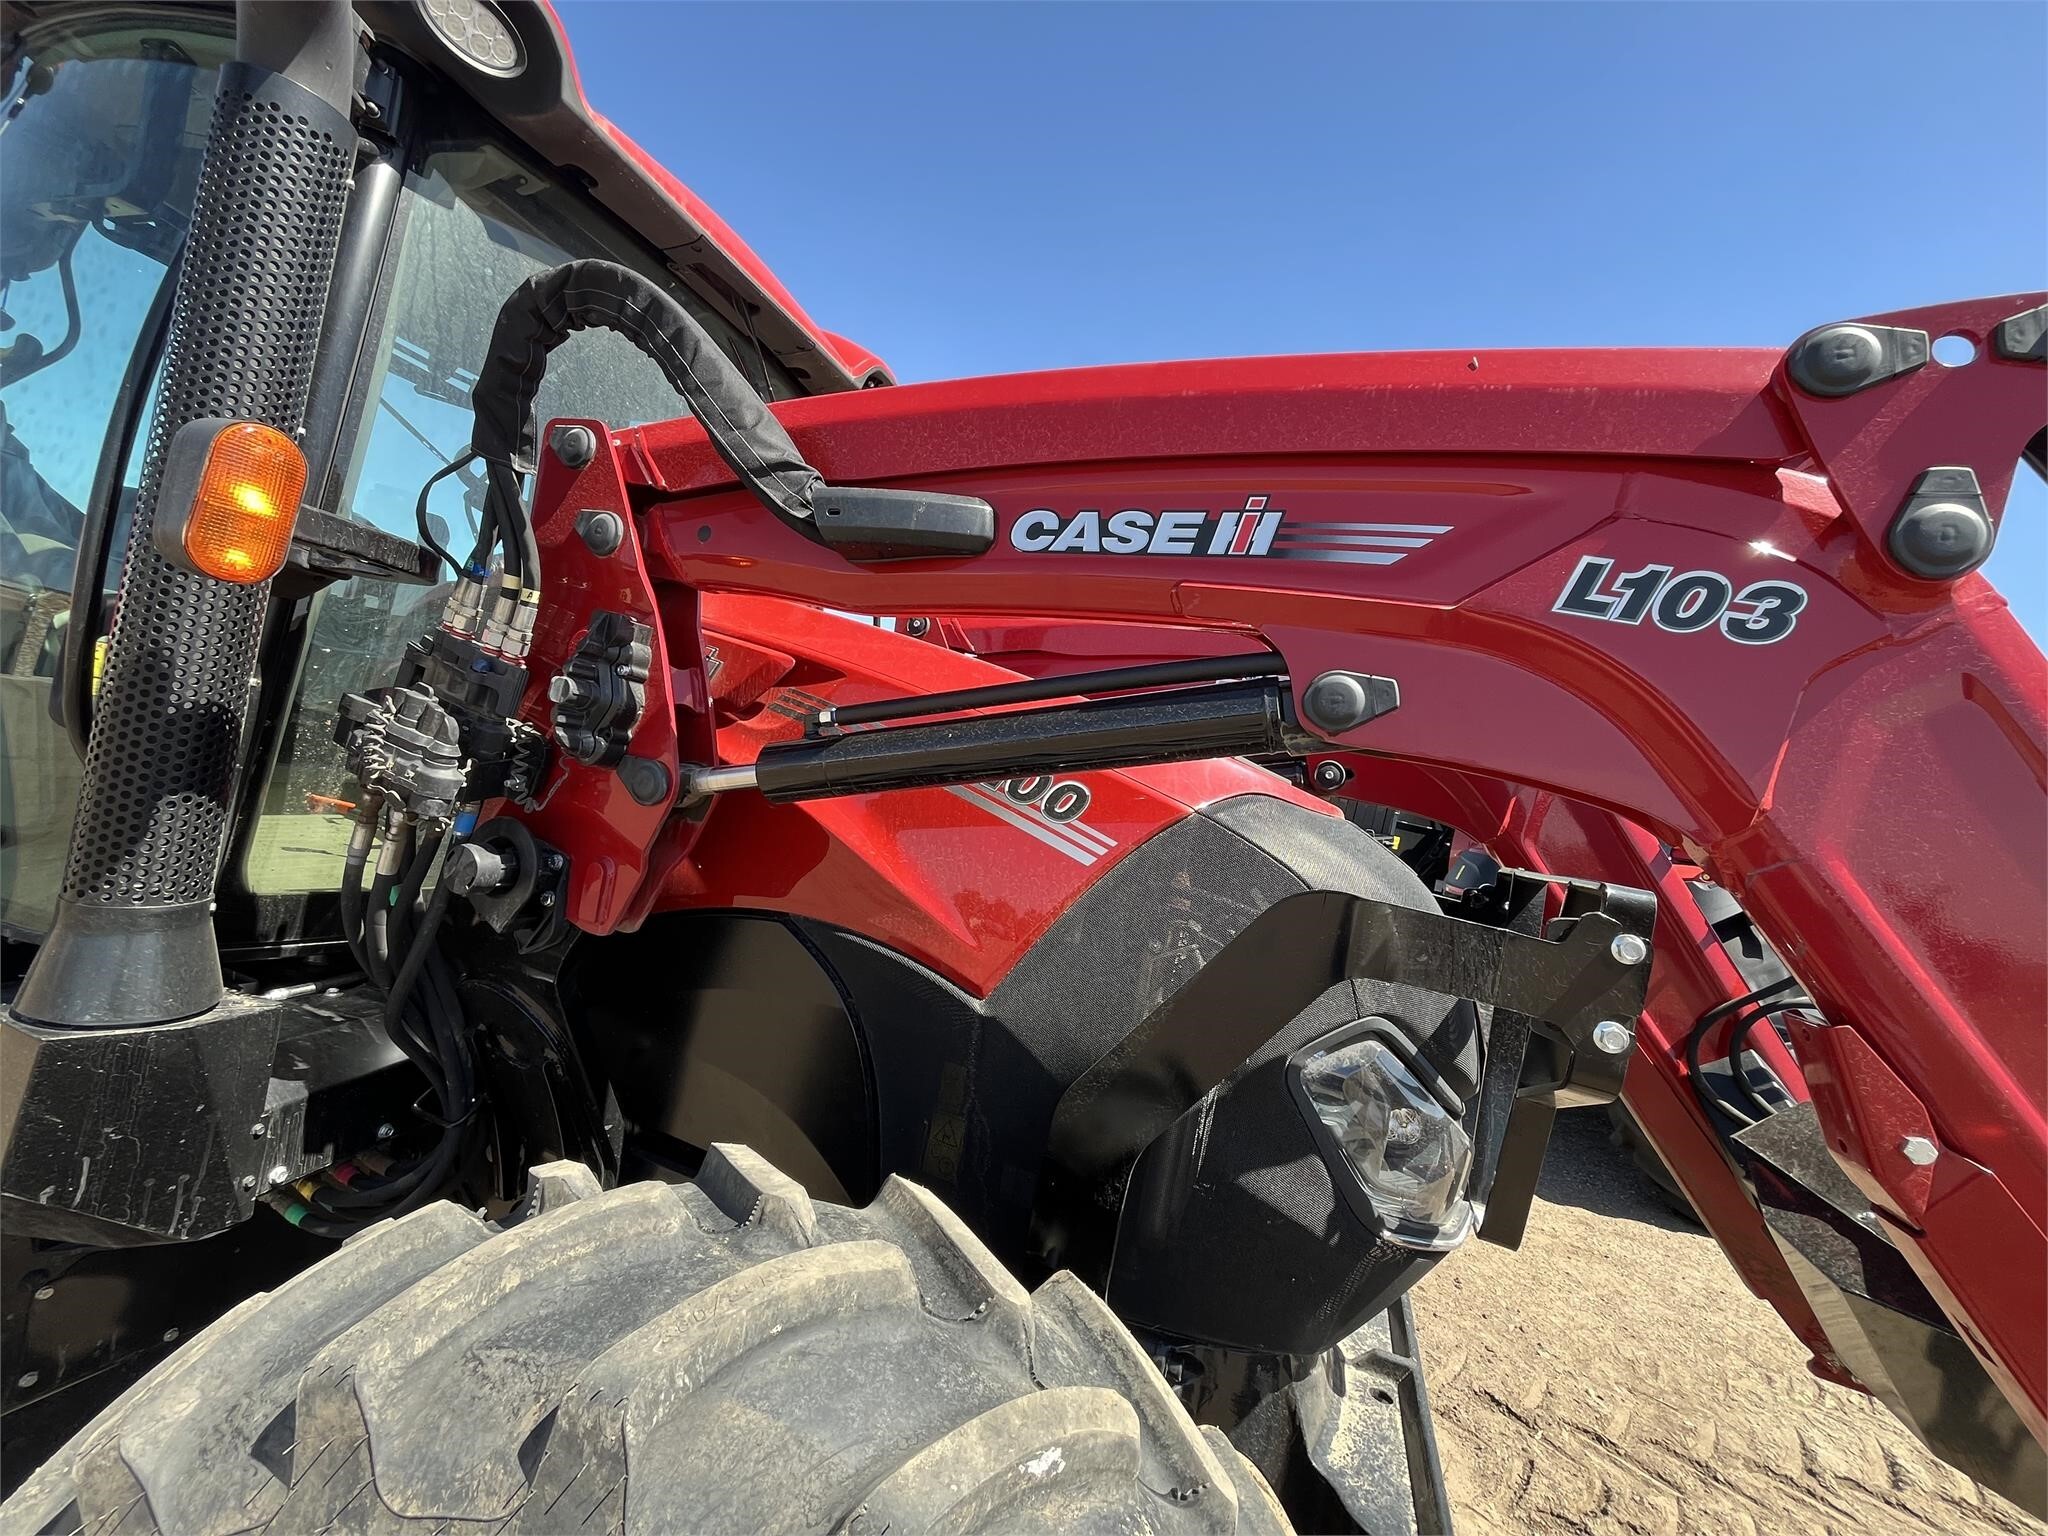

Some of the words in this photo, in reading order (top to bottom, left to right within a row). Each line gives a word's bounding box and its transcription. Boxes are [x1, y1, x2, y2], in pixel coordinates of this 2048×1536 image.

[1009, 509, 1207, 554] CASE
[1551, 555, 1809, 645] L103
[979, 774, 1092, 825] 00
